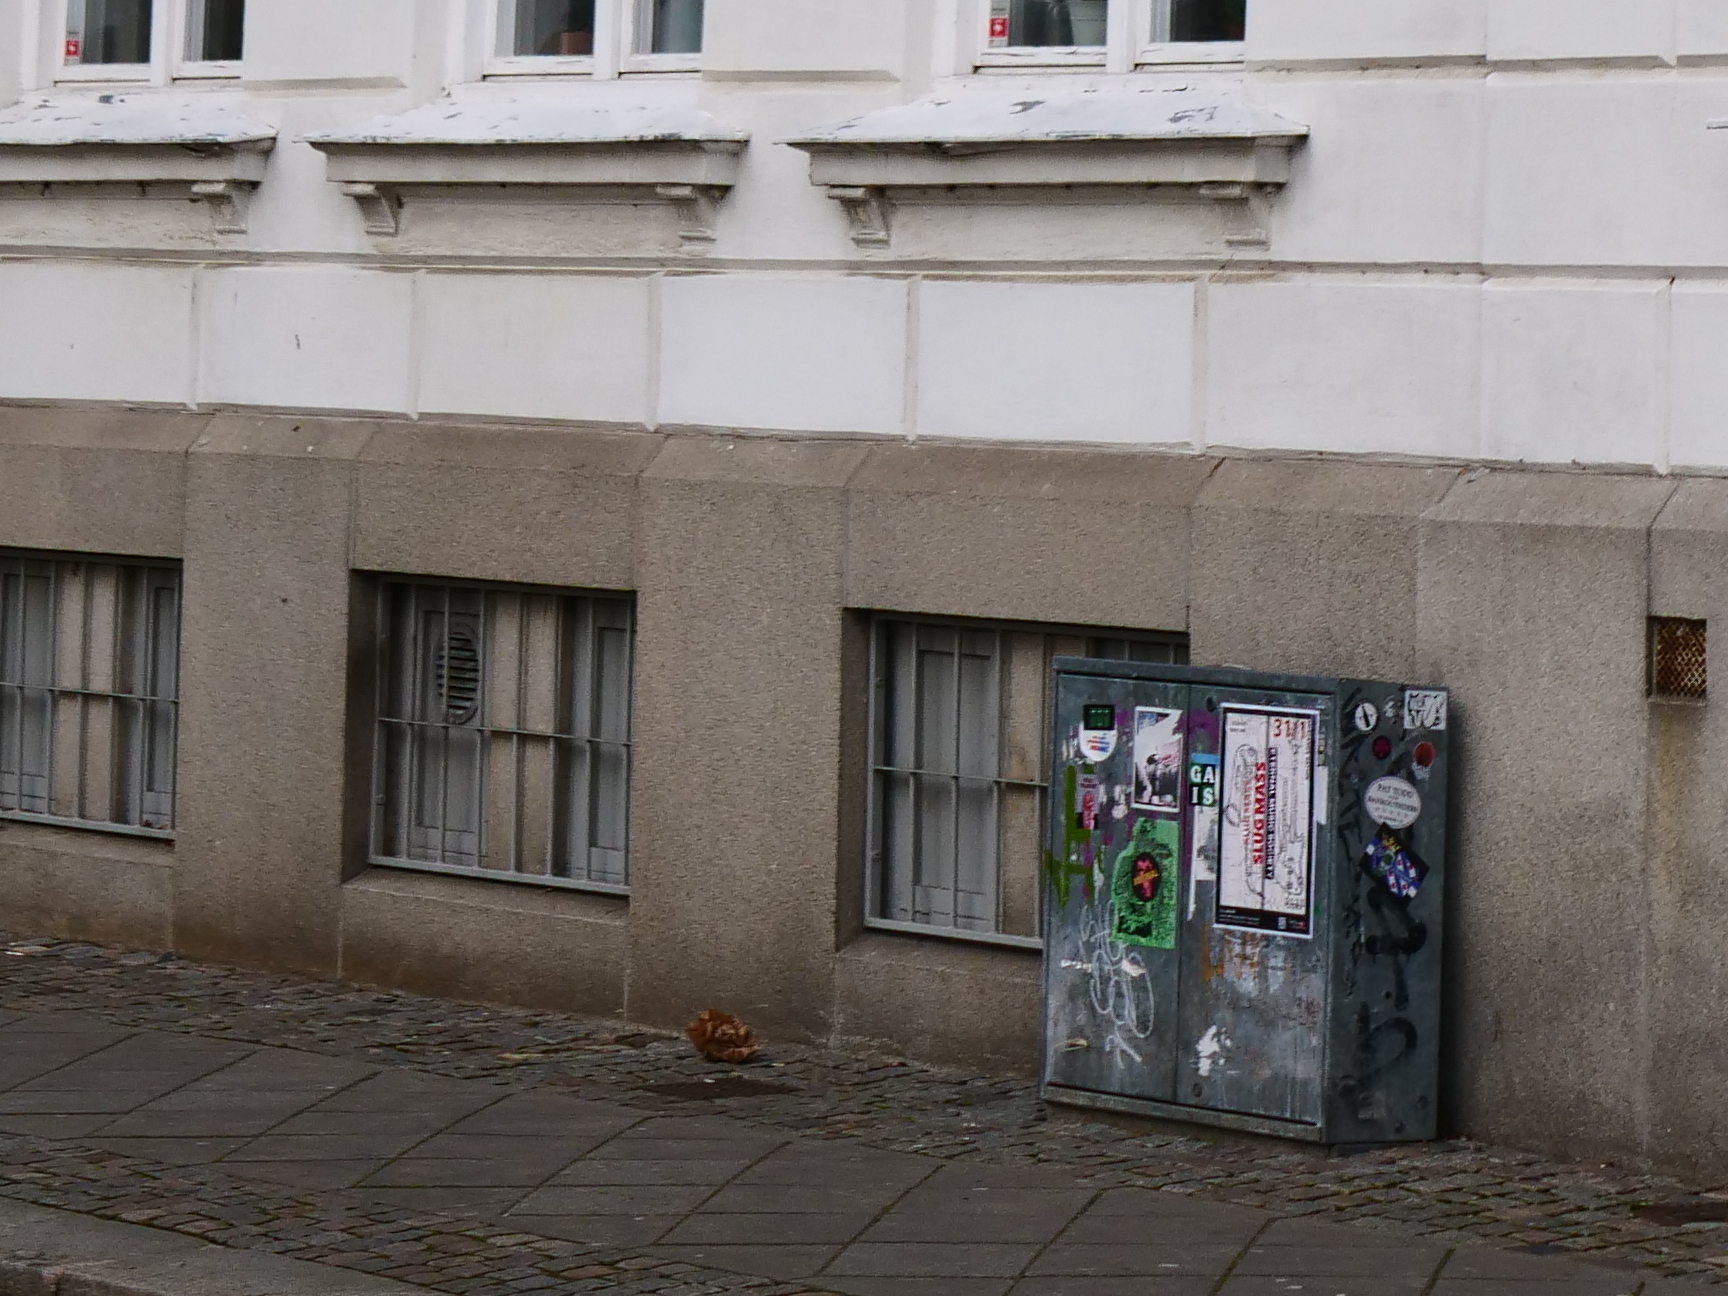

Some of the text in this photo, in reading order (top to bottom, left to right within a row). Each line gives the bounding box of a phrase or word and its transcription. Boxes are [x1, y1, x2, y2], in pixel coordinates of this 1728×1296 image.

[1273, 718, 1306, 740] 31/1
[1190, 765, 1215, 783] GA
[1191, 786, 1214, 805] IS
[1253, 761, 1267, 864] SLUG MASS
